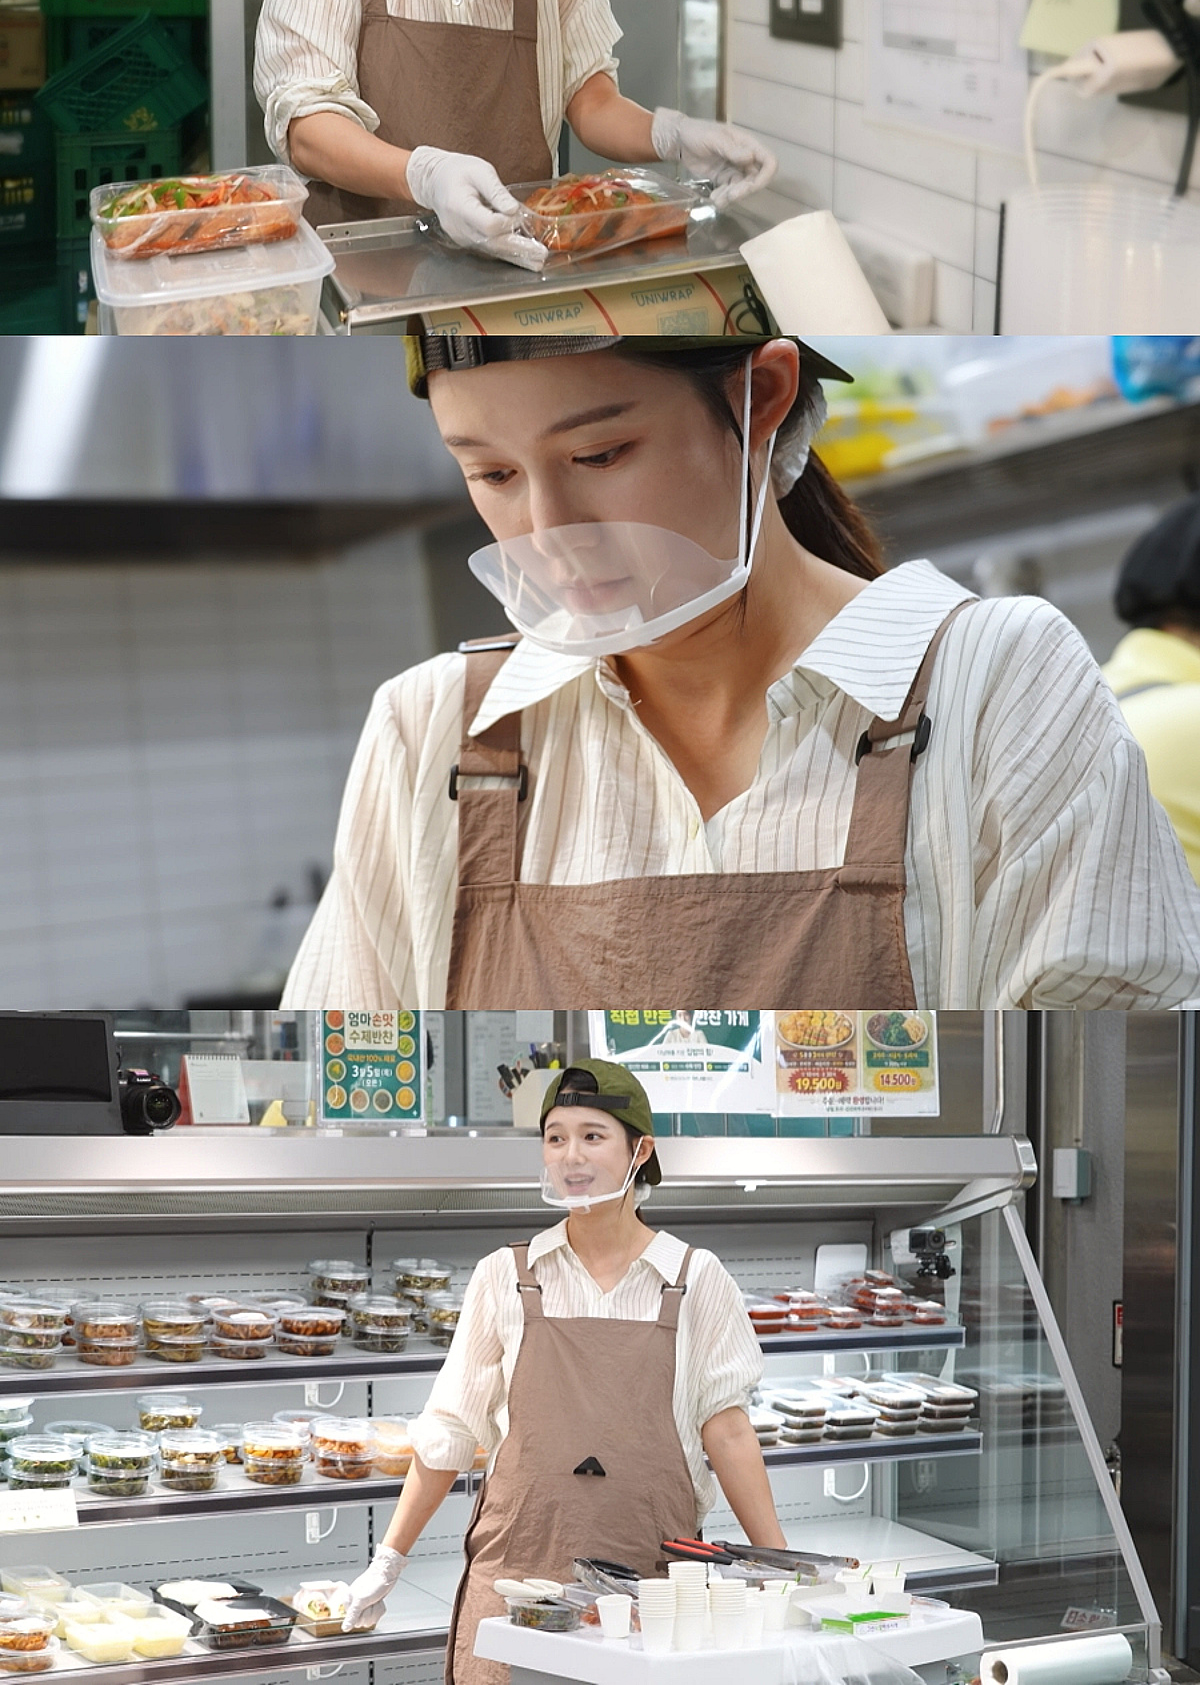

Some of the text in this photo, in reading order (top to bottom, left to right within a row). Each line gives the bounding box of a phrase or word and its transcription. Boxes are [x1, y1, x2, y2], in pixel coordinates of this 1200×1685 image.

[635, 288, 693, 307] UNIWRAP
[519, 307, 582, 327] UNIWRAP
[610, 1010, 640, 1025] 직접
[724, 1010, 750, 1027] 가게
[349, 1030, 394, 1045] 수제반찬
[796, 1077, 842, 1090] 19,500원
